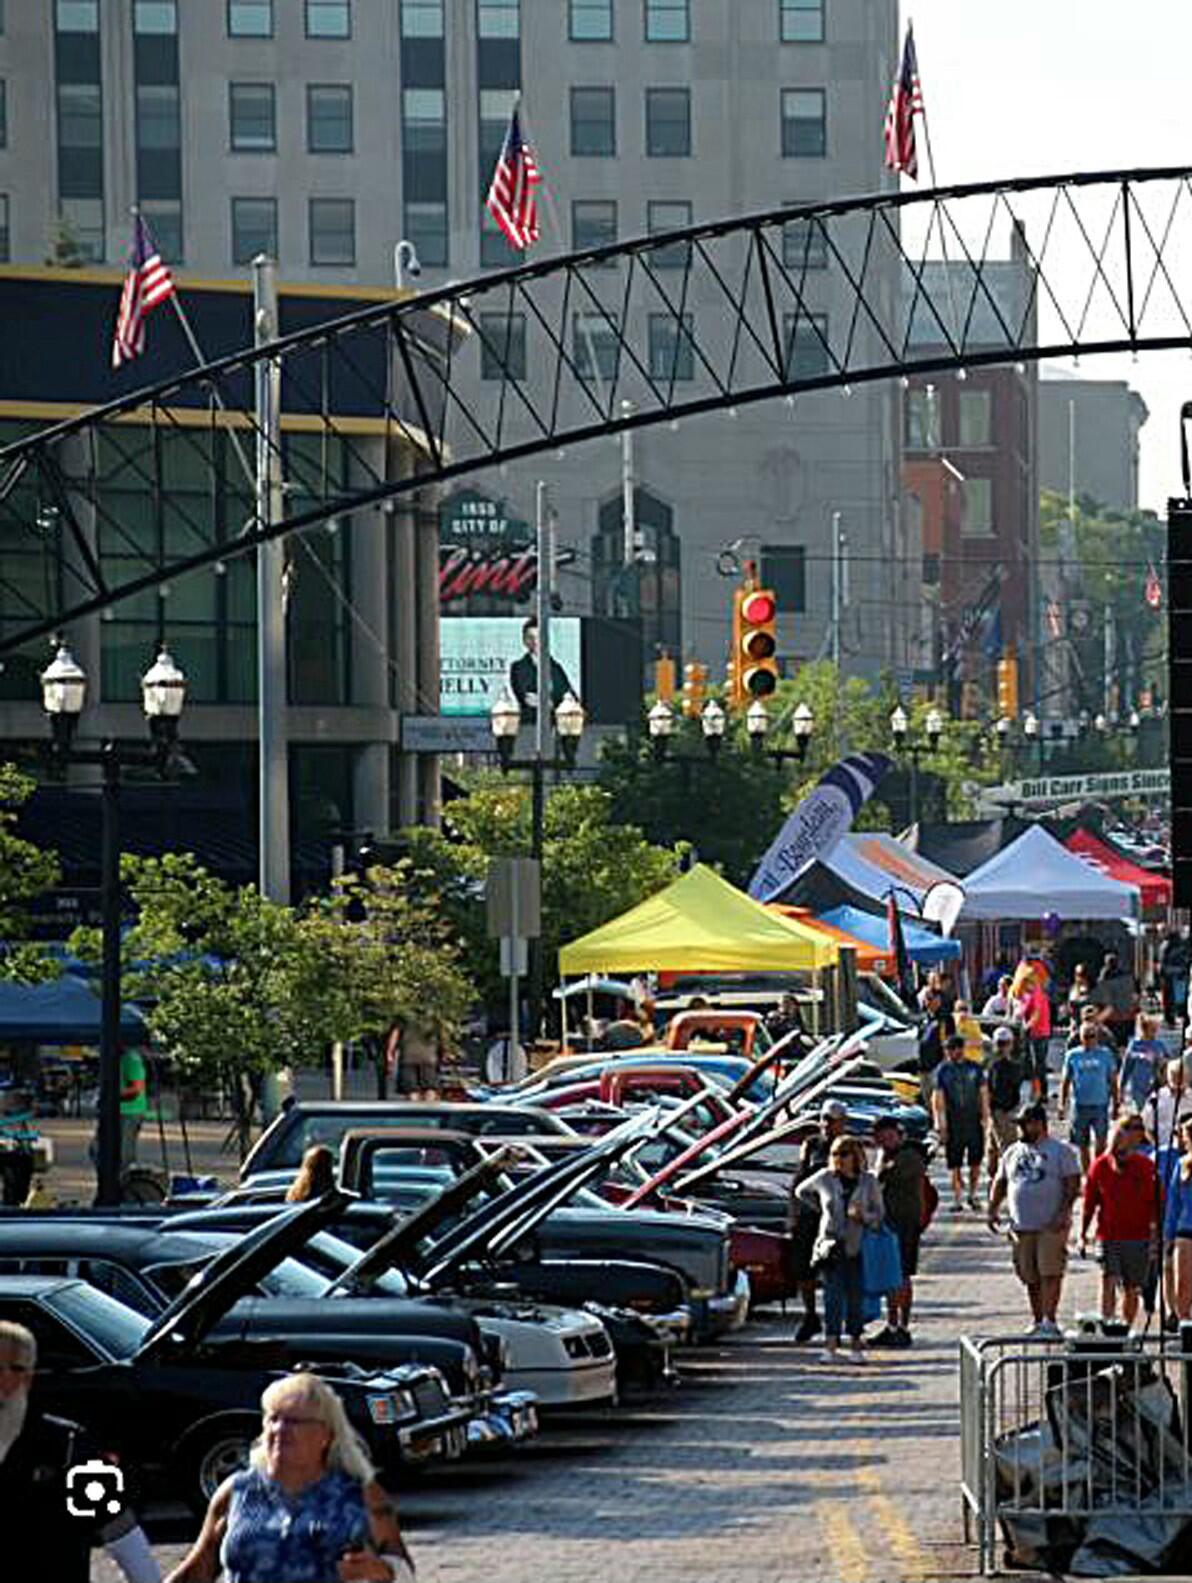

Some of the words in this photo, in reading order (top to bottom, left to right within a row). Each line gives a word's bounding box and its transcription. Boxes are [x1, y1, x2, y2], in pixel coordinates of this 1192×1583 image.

[451, 519, 486, 533] CITY
[489, 519, 507, 534] OF
[440, 543, 574, 601] lint
[440, 657, 507, 669] TTORNEY
[1022, 782, 1047, 798] Bill
[1051, 779, 1082, 795] Carr
[1086, 776, 1129, 793] Signs
